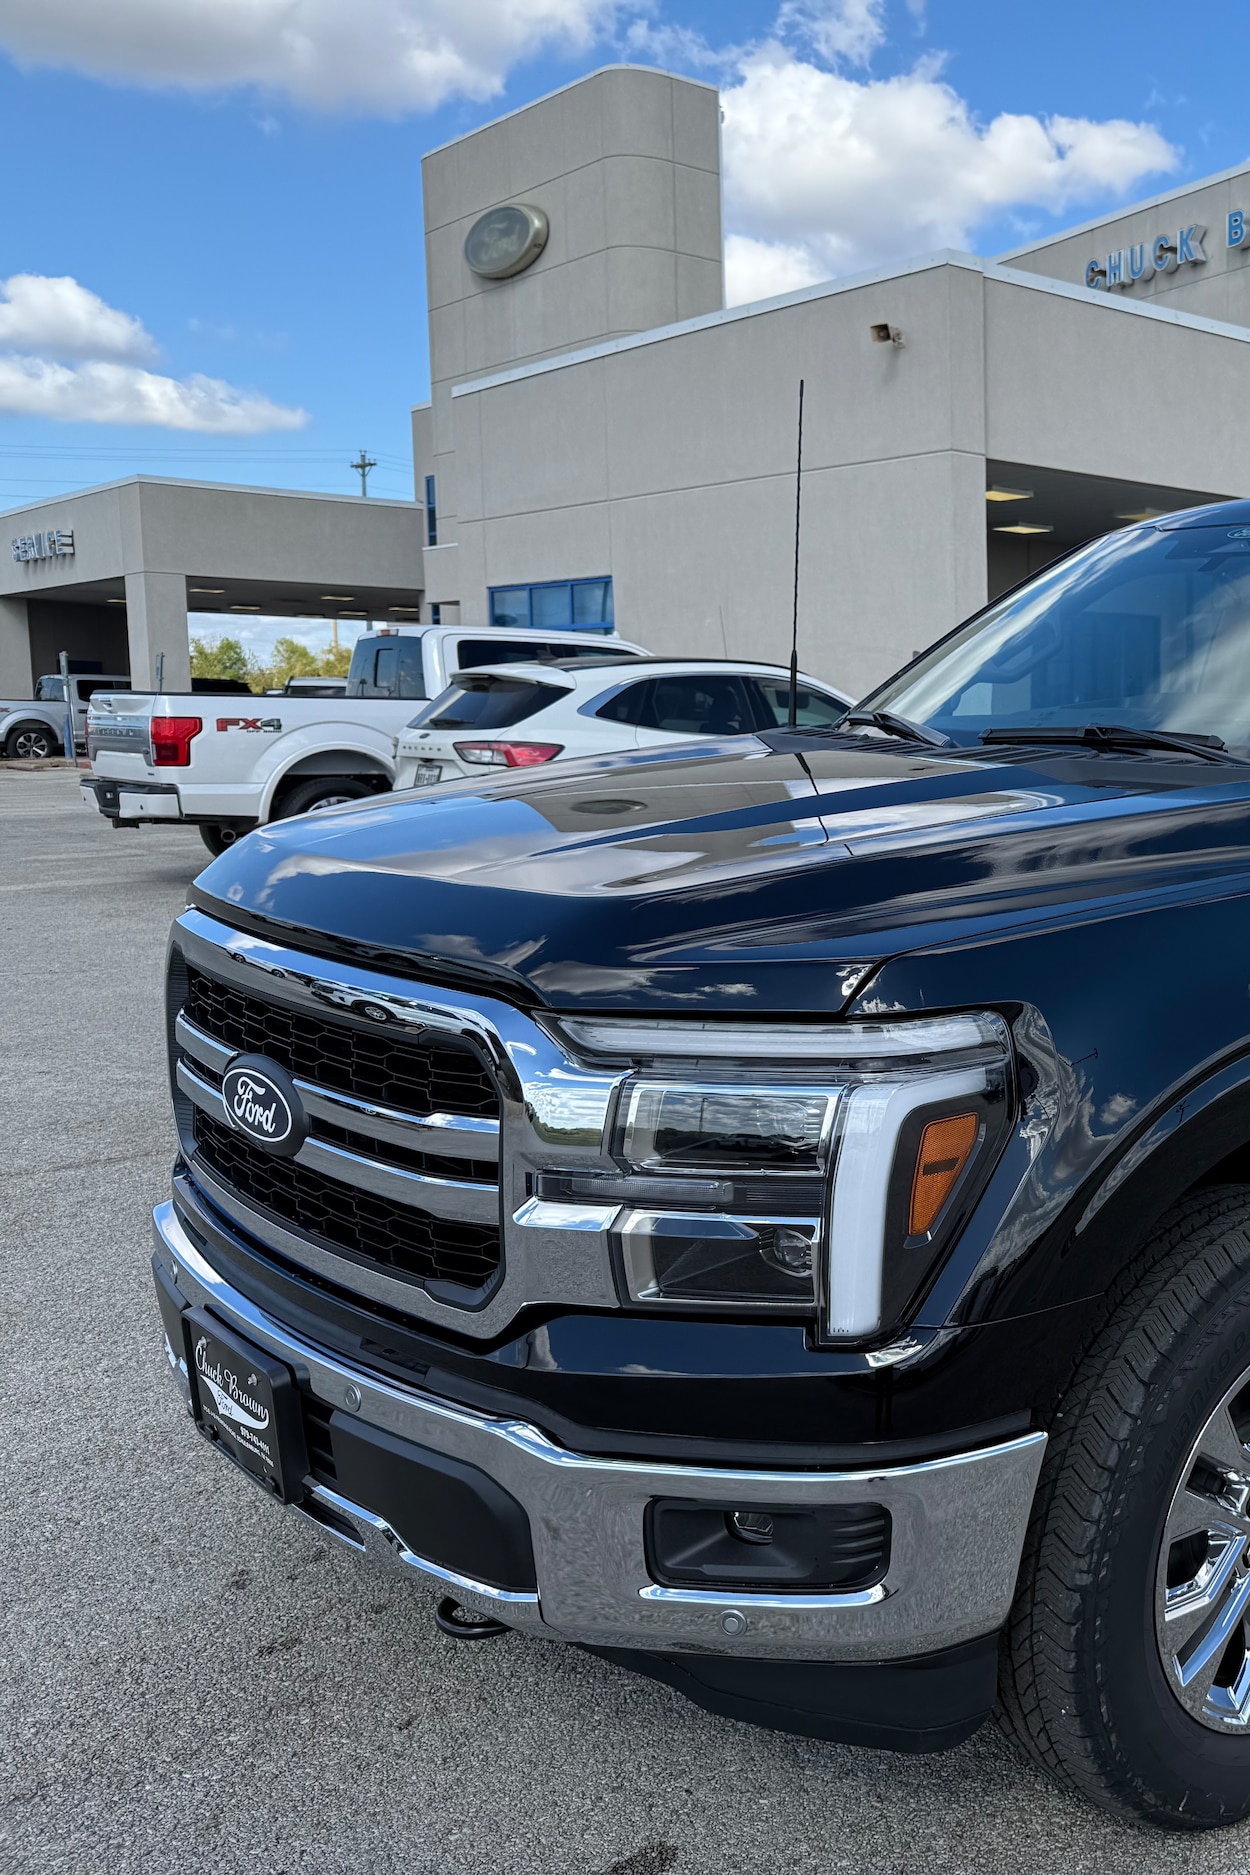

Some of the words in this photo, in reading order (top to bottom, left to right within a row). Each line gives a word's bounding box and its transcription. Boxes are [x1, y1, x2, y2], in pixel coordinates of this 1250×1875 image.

[1085, 225, 1204, 289] CHUCK
[216, 718, 282, 732] FX4
[234, 1076, 277, 1133] Ford
[195, 1345, 224, 1388] Chuck
[223, 1369, 270, 1421] Brown
